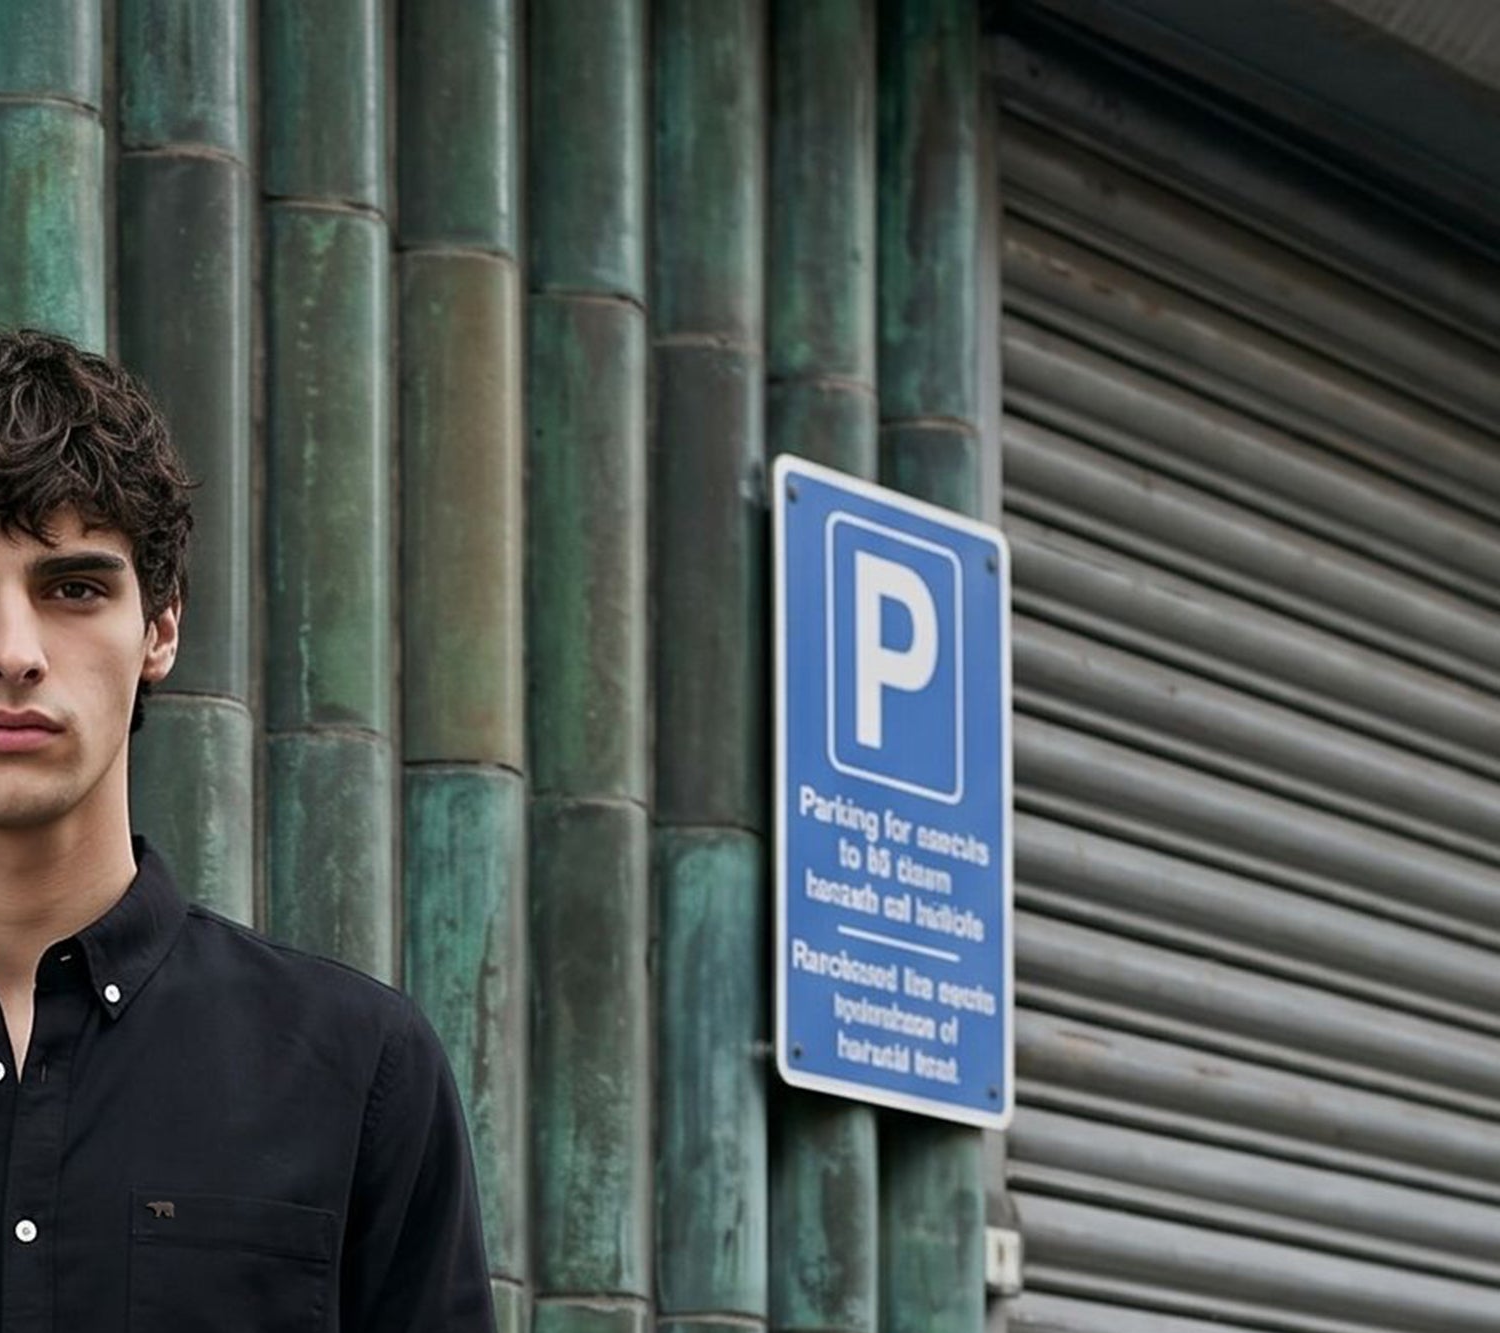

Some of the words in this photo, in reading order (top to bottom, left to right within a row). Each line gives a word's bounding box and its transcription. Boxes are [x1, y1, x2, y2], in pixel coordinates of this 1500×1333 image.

[855, 550, 939, 749] P
[800, 785, 879, 842] Parking
[884, 809, 913, 844] for
